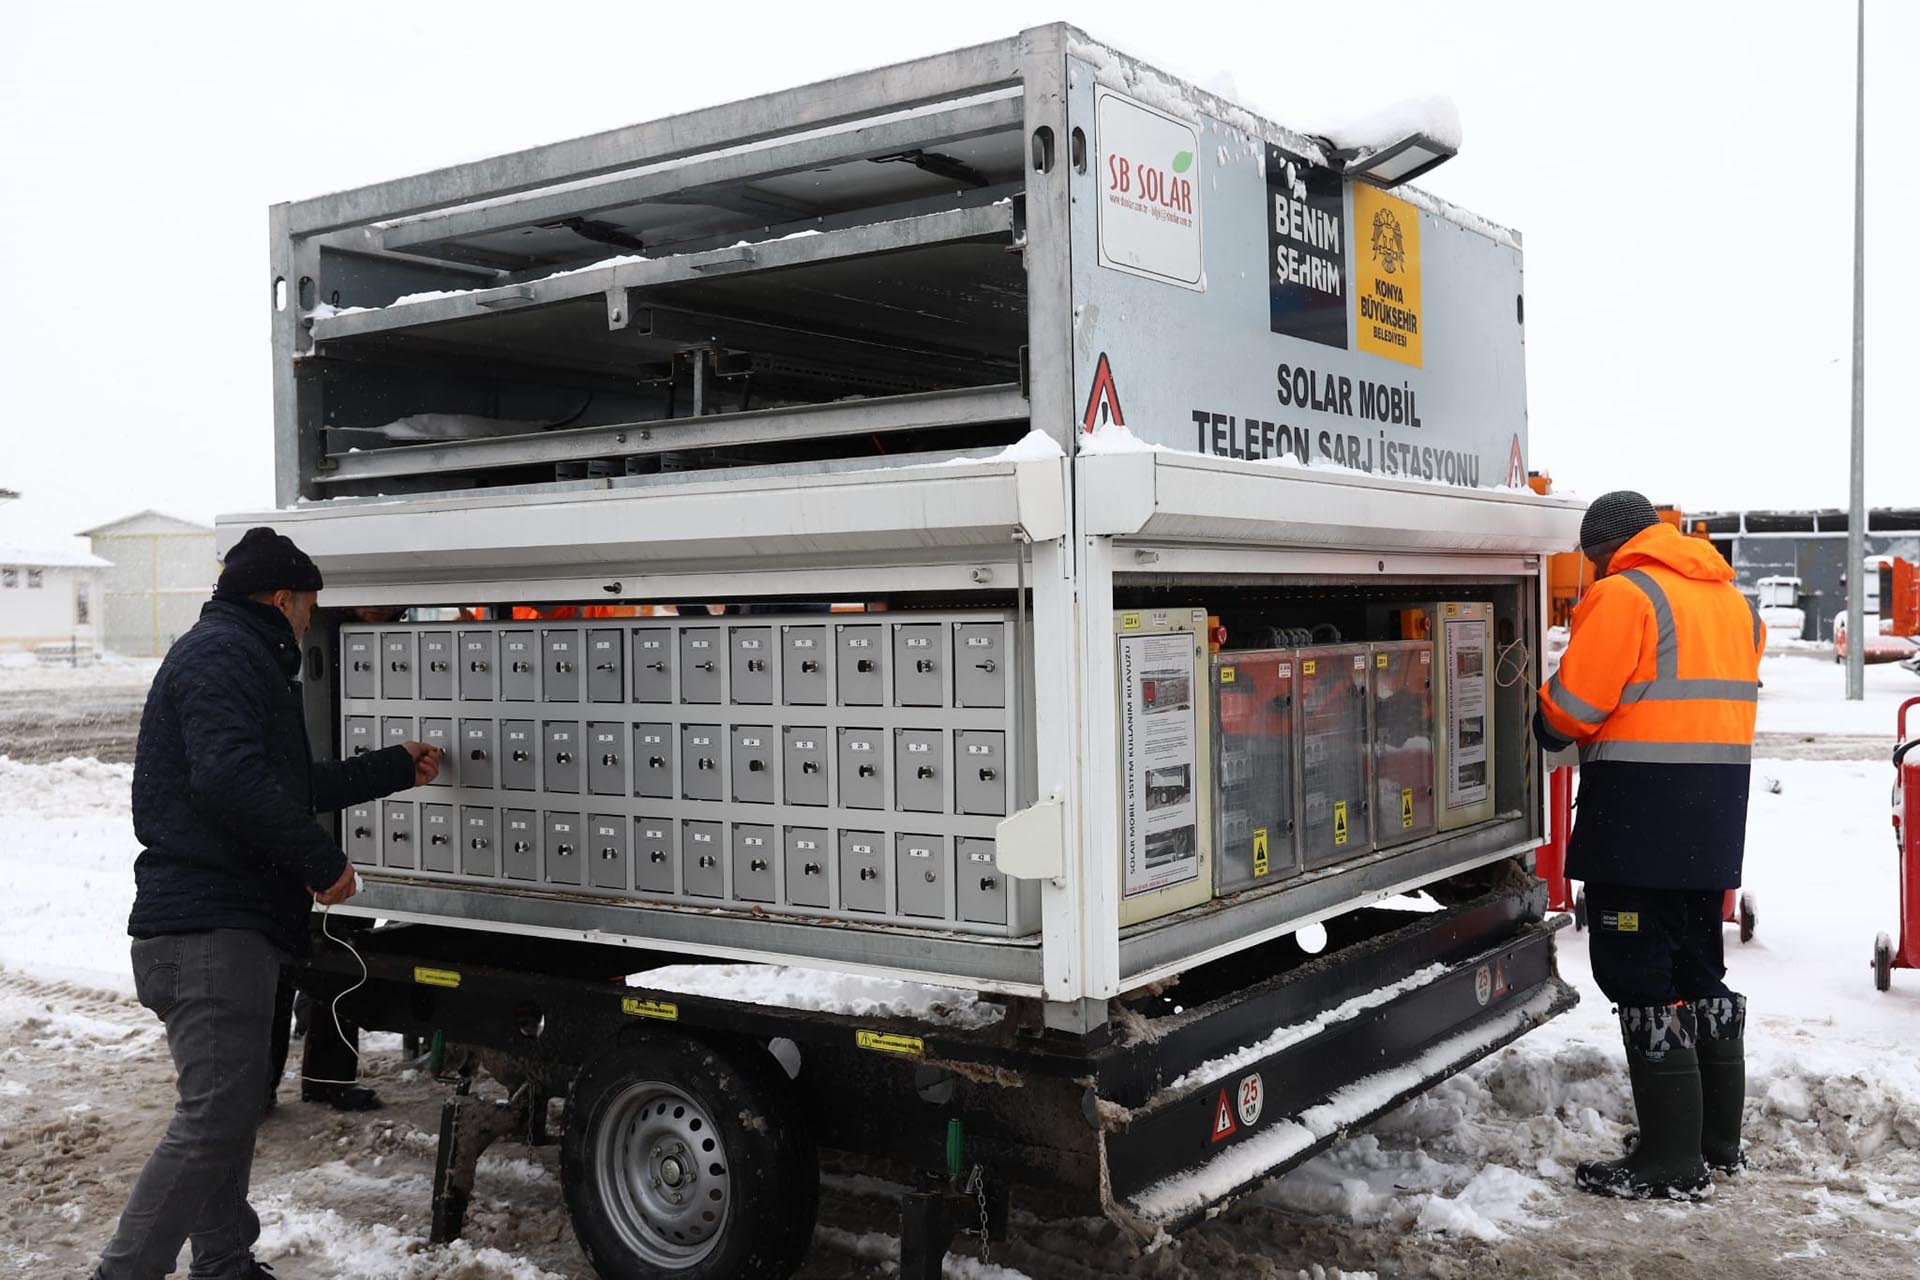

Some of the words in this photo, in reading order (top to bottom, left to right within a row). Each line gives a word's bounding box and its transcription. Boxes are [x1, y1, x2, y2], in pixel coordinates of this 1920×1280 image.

[1109, 154, 1130, 192] SB
[1138, 164, 1192, 214] SOLAR
[1375, 278, 1404, 304] KONYA
[1360, 294, 1417, 334] BÜYÜKŞEHİR
[1373, 325, 1407, 348] BELEDİYESİ
[1277, 363, 1353, 416] SOLAR
[1359, 380, 1421, 428] MOBİL
[1192, 409, 1310, 466] TELEFON
[1380, 430, 1479, 488] İSTASYONU
[1479, 969, 1487, 989] 25
[1243, 1078, 1258, 1105] 25
